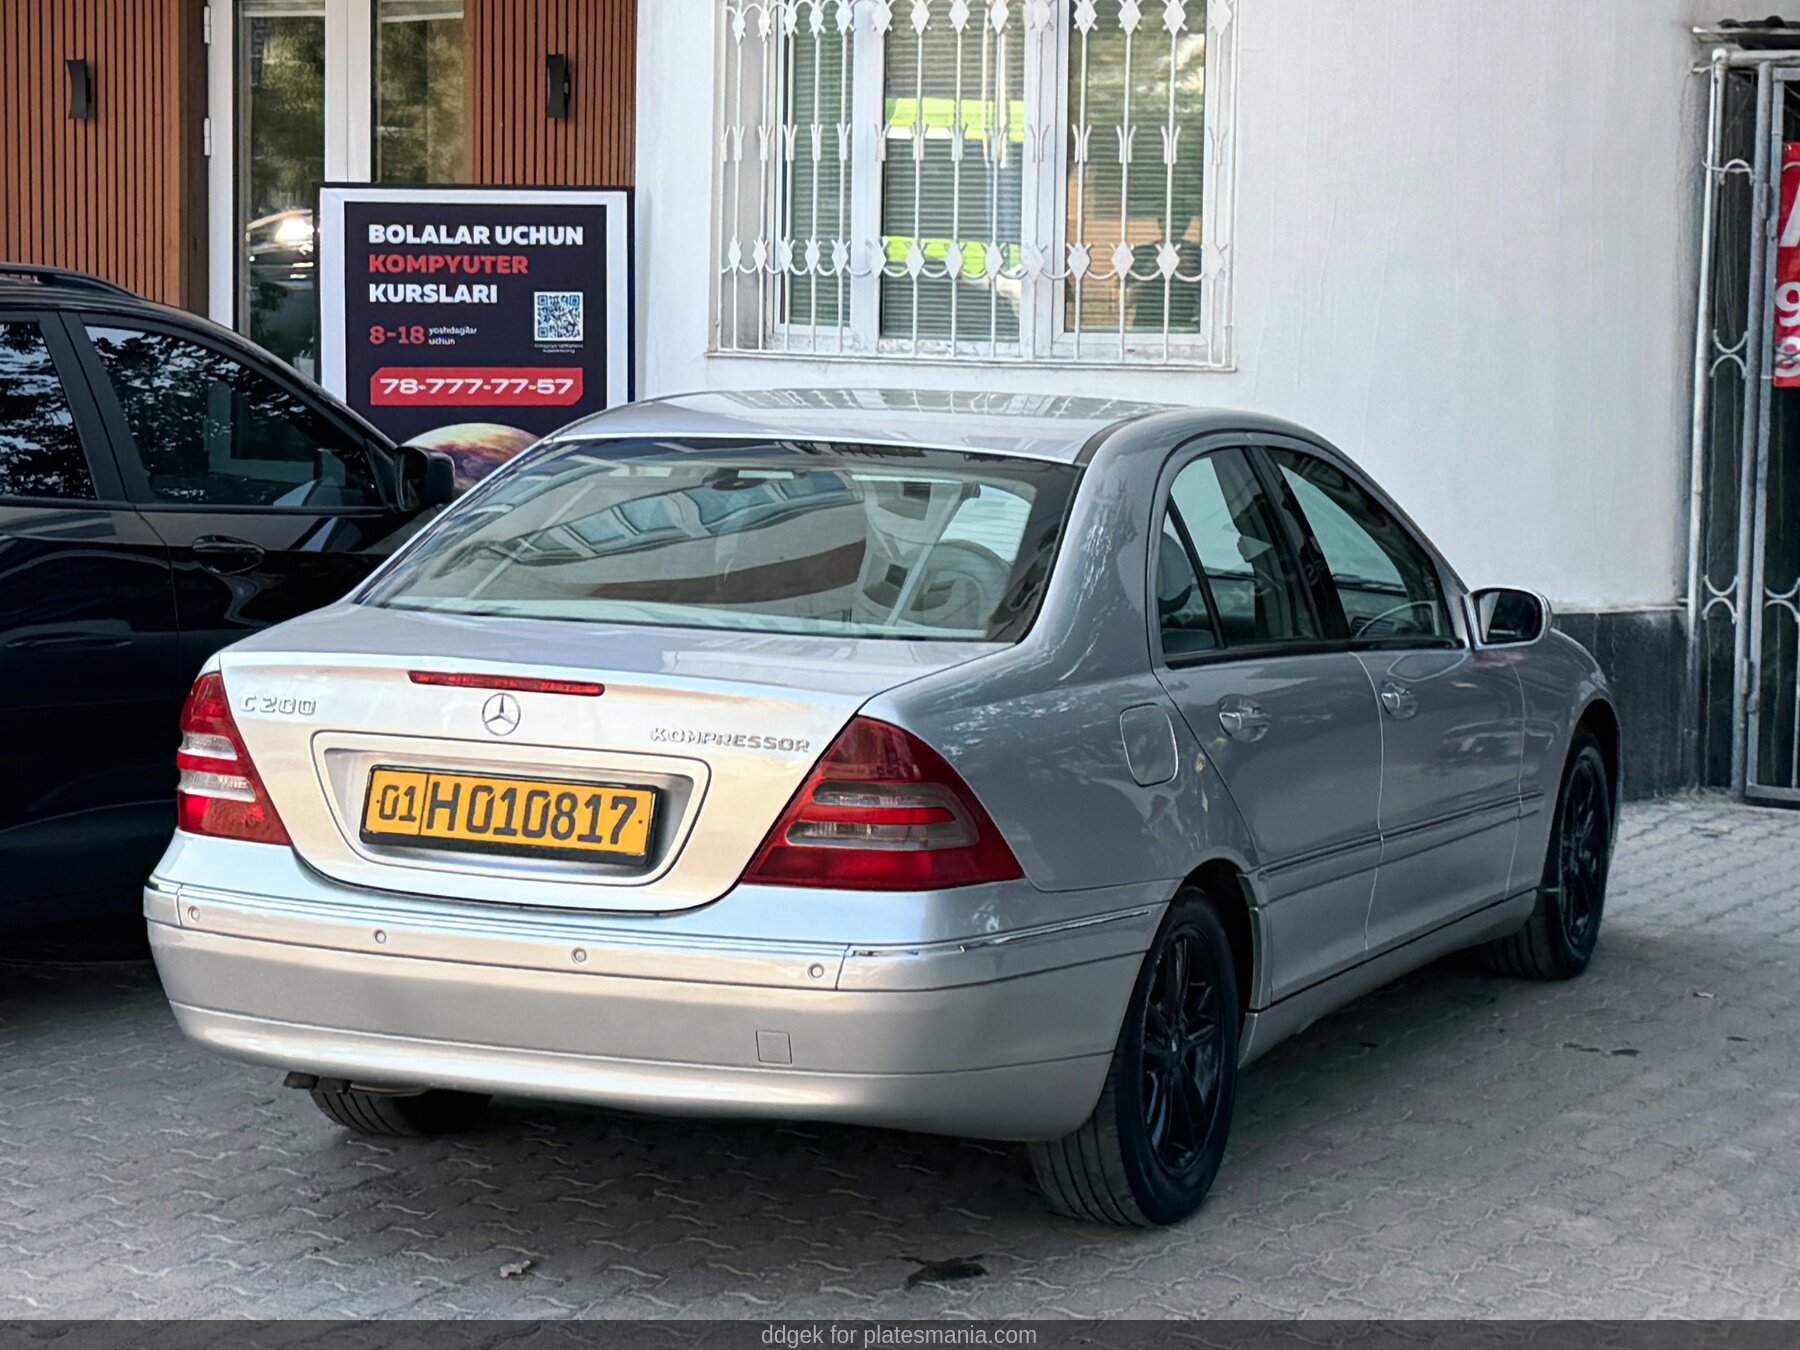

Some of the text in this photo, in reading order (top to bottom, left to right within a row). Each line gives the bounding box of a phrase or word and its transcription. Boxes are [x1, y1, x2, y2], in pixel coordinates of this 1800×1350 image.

[369, 225, 583, 246] BOLALAR UCHUN
[369, 255, 528, 275] KOMPYUTER
[369, 284, 497, 304] KURSLARI
[369, 325, 425, 345] 8-18
[380, 378, 574, 394] 78-777-77-57
[241, 695, 316, 715] C 200
[651, 727, 810, 752] KOMPRESSOR
[378, 781, 637, 844] 01 H010817
